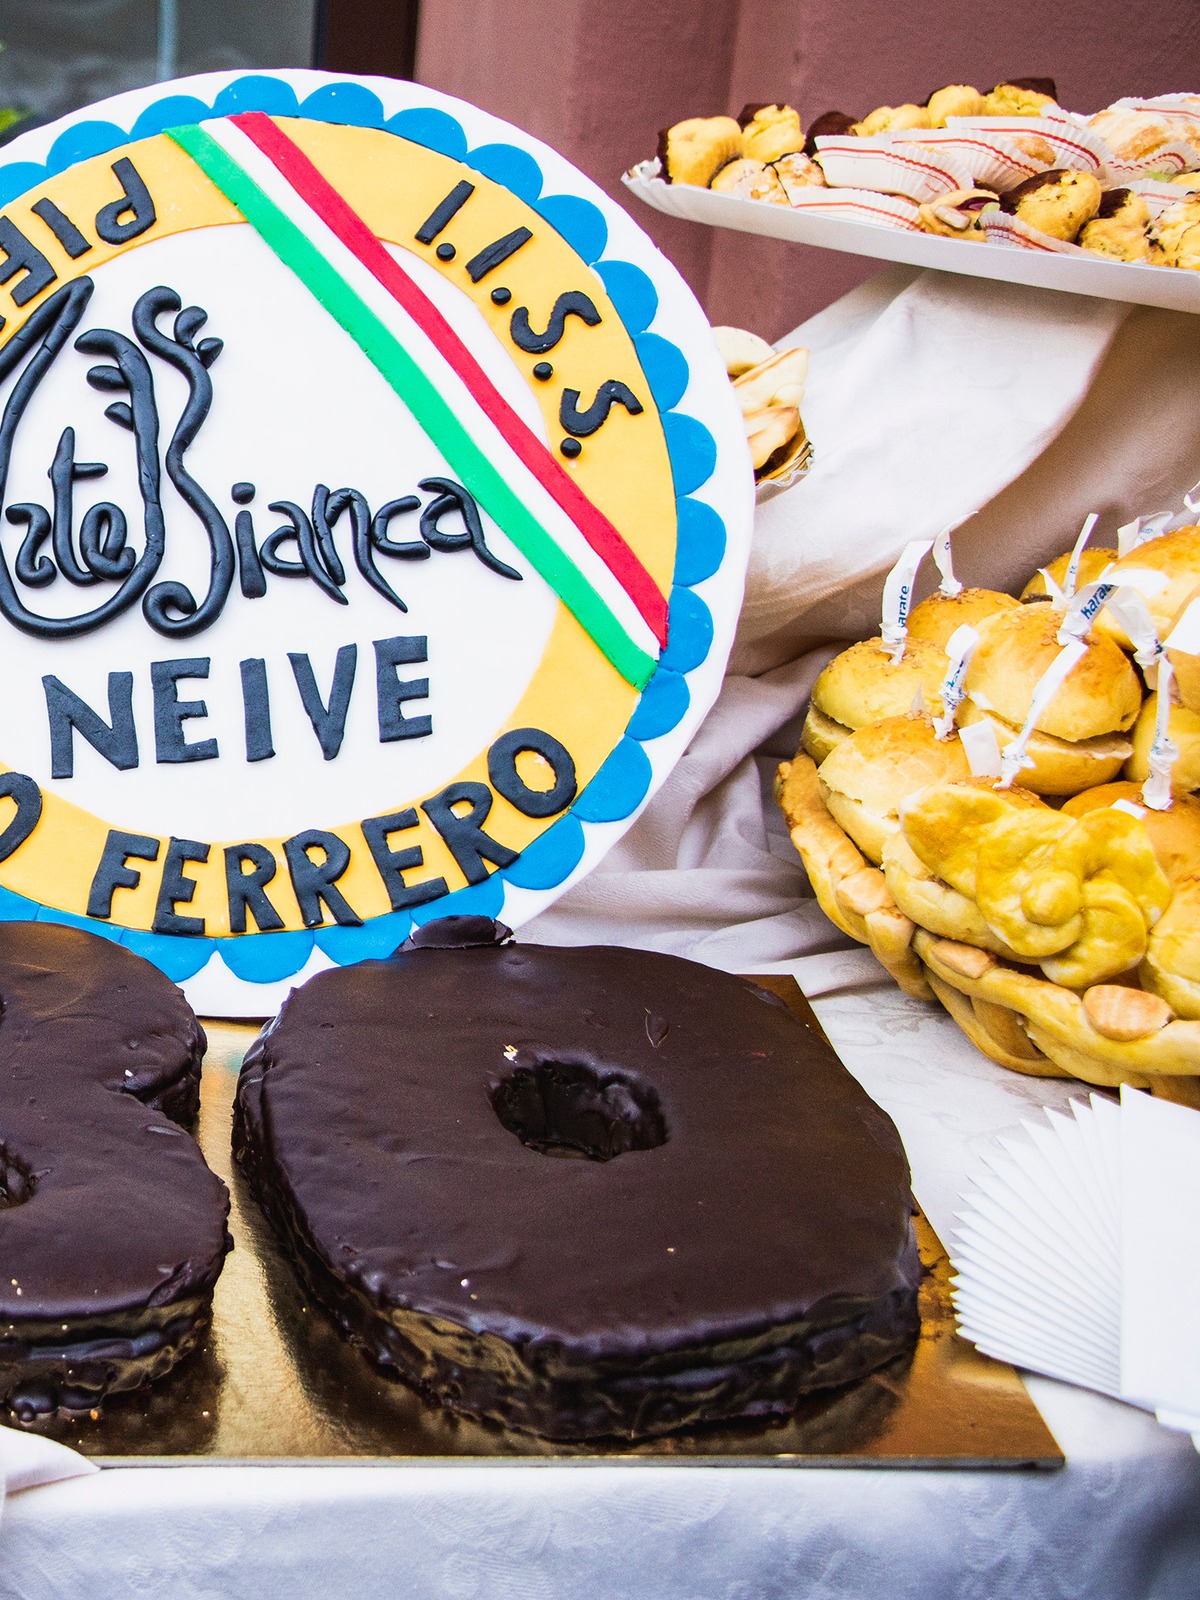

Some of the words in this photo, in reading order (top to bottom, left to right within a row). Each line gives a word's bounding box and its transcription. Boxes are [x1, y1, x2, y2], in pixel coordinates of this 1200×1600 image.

[1081, 583, 1116, 620] karat
[40, 634, 434, 780] NEIVE
[85, 726, 578, 935] FERRERO
